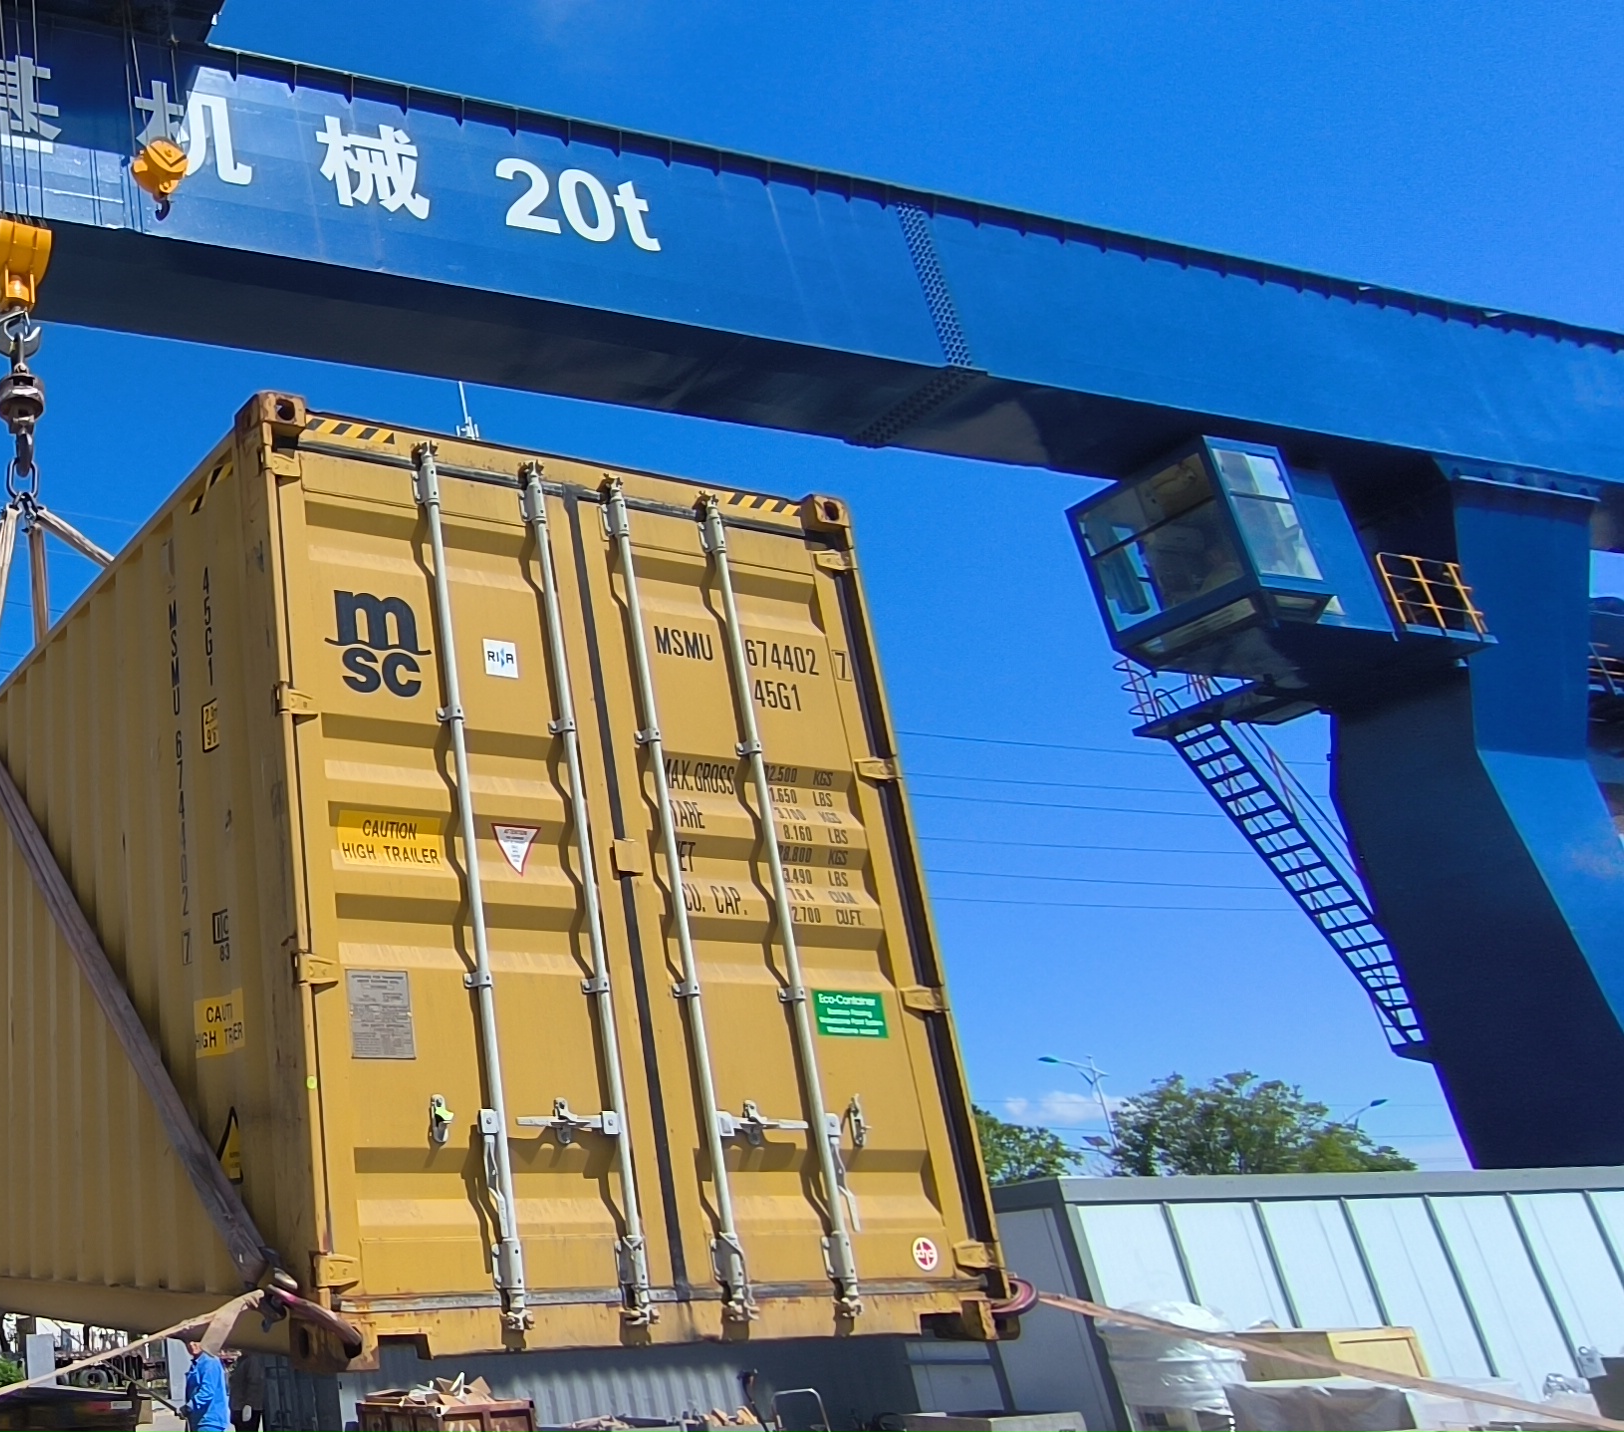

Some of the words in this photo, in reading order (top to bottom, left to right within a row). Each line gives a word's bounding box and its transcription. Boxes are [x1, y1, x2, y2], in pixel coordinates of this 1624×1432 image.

[494, 157, 661, 252] 20t
[654, 625, 713, 661] MSMU
[745, 639, 819, 676] 674402
[835, 652, 846, 679] 7
[755, 679, 801, 711] 45G1
[813, 769, 833, 787] KGS
[813, 791, 833, 807] LBS
[363, 820, 417, 840] CAUTION
[783, 824, 812, 841] 8.160
[828, 827, 848, 844] LBS
[342, 843, 377, 860] HIGH
[383, 846, 441, 864] TRAILER
[828, 849, 848, 866] KGS
[828, 870, 848, 887] LBS
